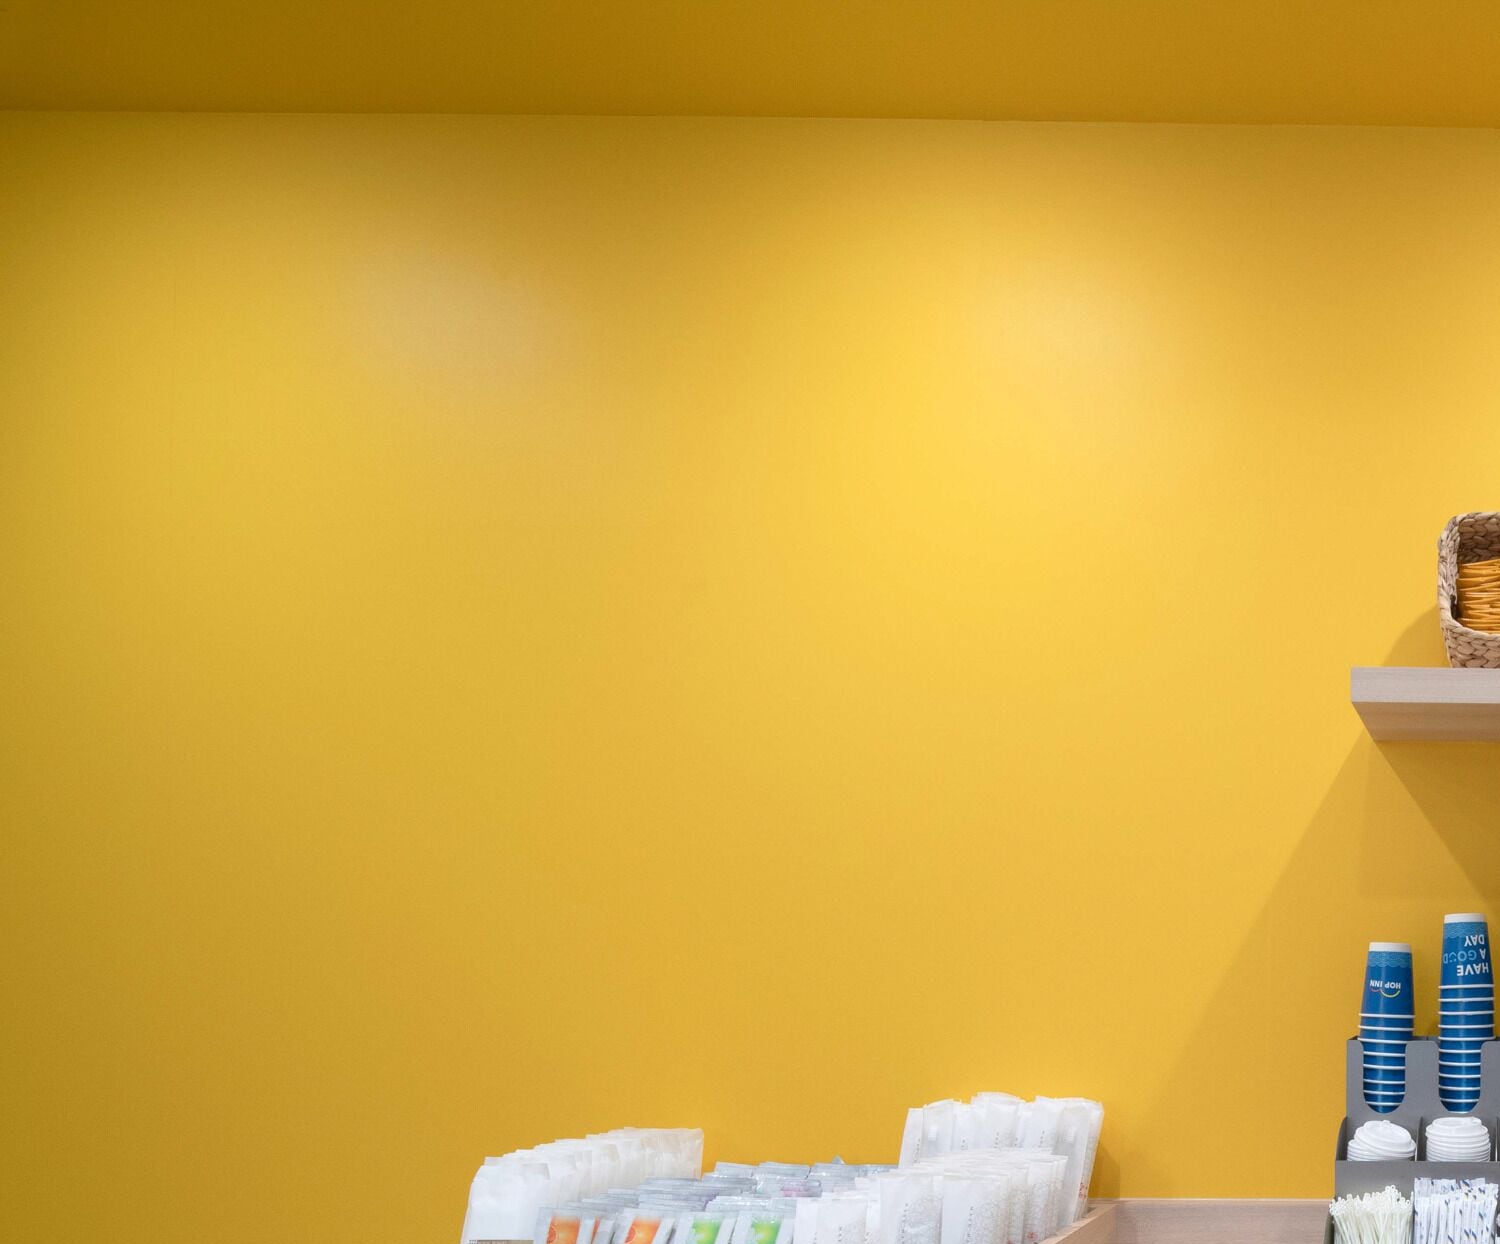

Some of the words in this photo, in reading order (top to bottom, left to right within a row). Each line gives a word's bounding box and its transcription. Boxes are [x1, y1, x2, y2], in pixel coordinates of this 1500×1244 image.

[1464, 934, 1485, 947] DAY
[1479, 948, 1486, 960] A
[1456, 962, 1489, 977] HAVE
[1369, 979, 1383, 988] INN
[1384, 981, 1401, 989] HOP
